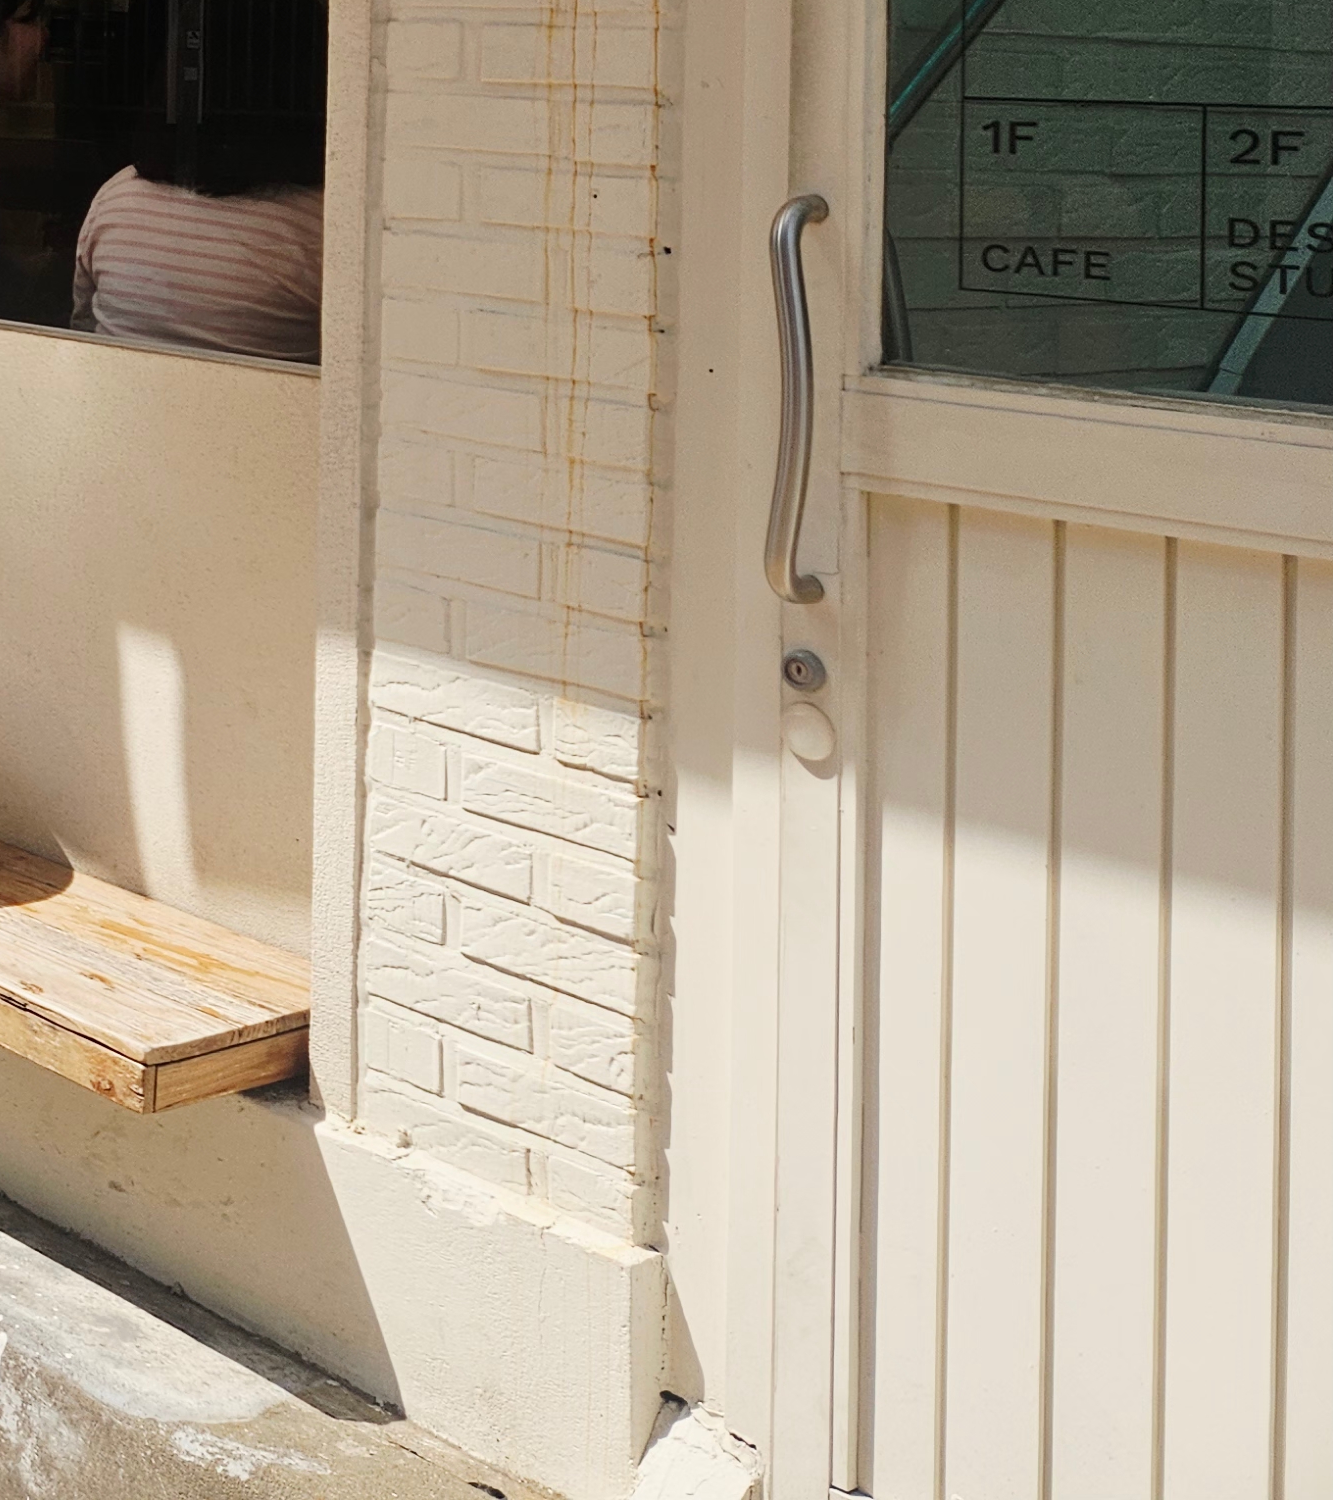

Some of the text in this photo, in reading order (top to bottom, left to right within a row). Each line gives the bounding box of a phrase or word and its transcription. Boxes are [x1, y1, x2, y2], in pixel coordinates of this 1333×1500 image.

[981, 120, 1038, 155] 1F
[1228, 129, 1305, 166] 2F
[981, 243, 1112, 282] CAFE
